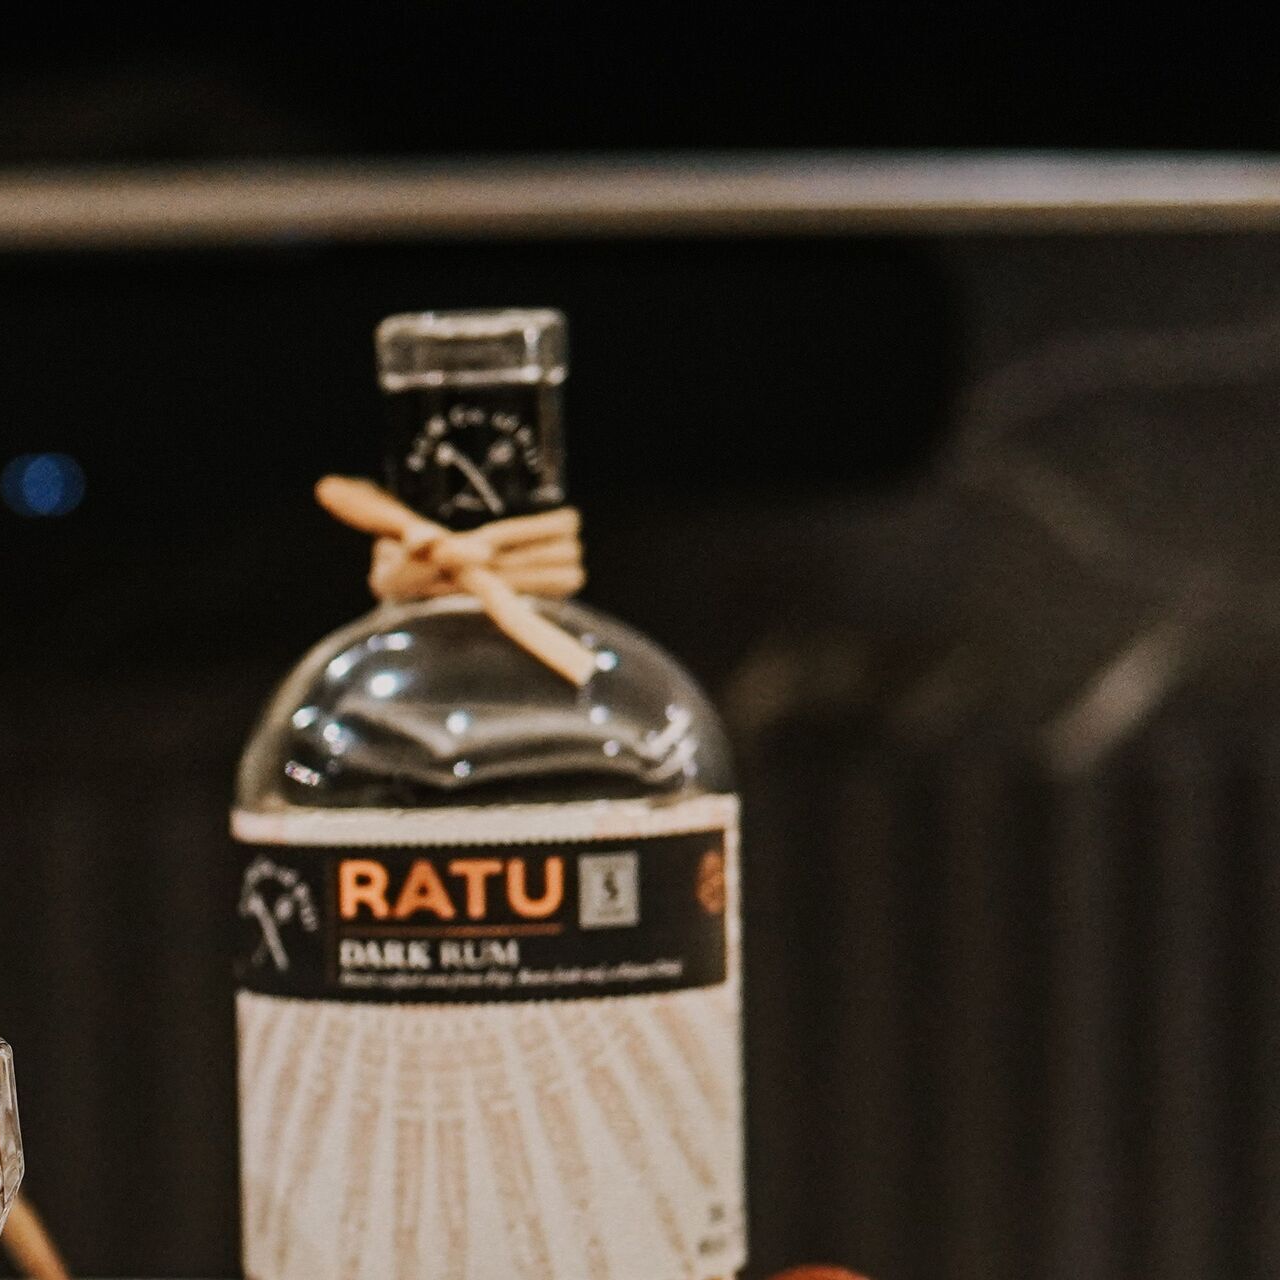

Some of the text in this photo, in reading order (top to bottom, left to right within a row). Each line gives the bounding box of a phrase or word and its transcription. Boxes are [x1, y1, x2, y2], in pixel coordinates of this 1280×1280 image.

[339, 856, 565, 921] RATU
[340, 937, 432, 971] DARK
[439, 937, 520, 971] RUM
